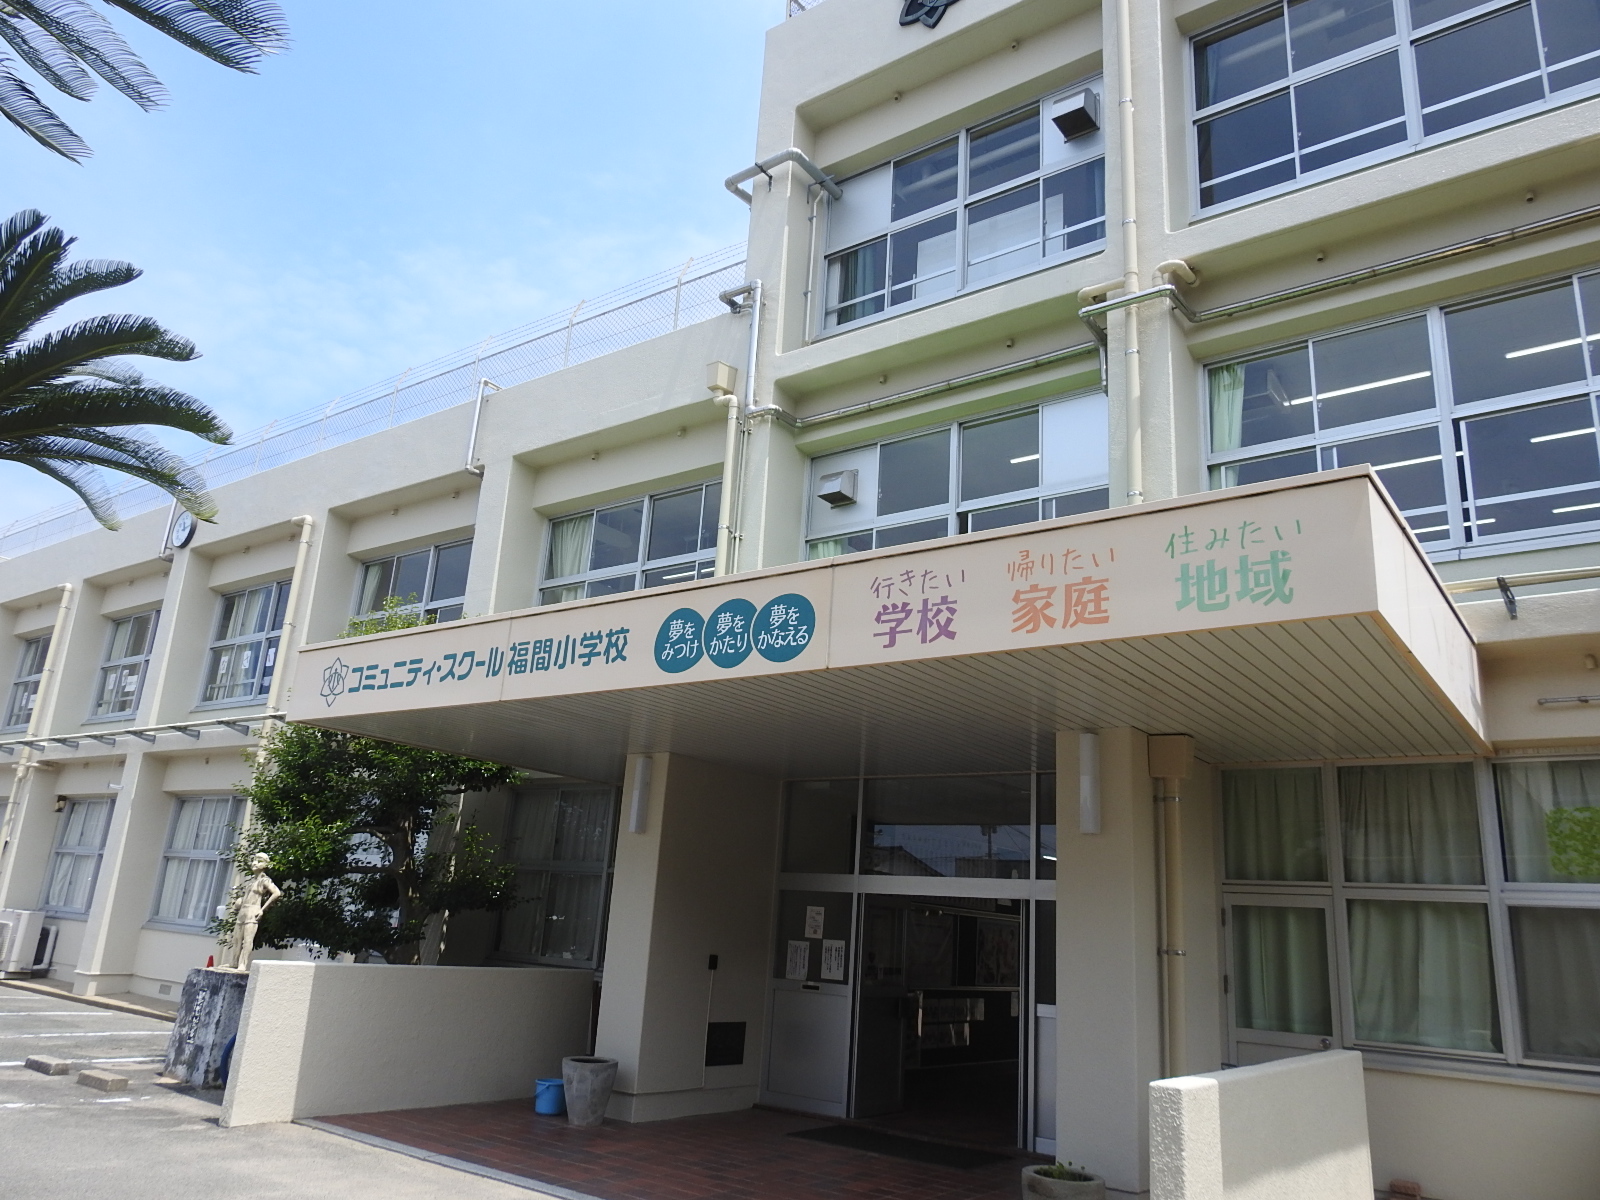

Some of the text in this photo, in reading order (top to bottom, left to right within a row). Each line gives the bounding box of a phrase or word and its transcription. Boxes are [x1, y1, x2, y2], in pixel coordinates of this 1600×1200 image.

[1165, 519, 1302, 559] 住みたい
[1007, 548, 1115, 582] 帰りたい
[870, 569, 965, 599] 行きたい
[1175, 550, 1294, 612] 地域
[769, 604, 800, 629] 夢を
[1011, 576, 1110, 634] 家庭
[668, 619, 696, 643] 夢を
[716, 612, 745, 636] 夢を
[873, 595, 958, 649] 学校
[661, 639, 700, 661] みつけ
[709, 633, 748, 656] かたり
[757, 625, 809, 650] かなえる
